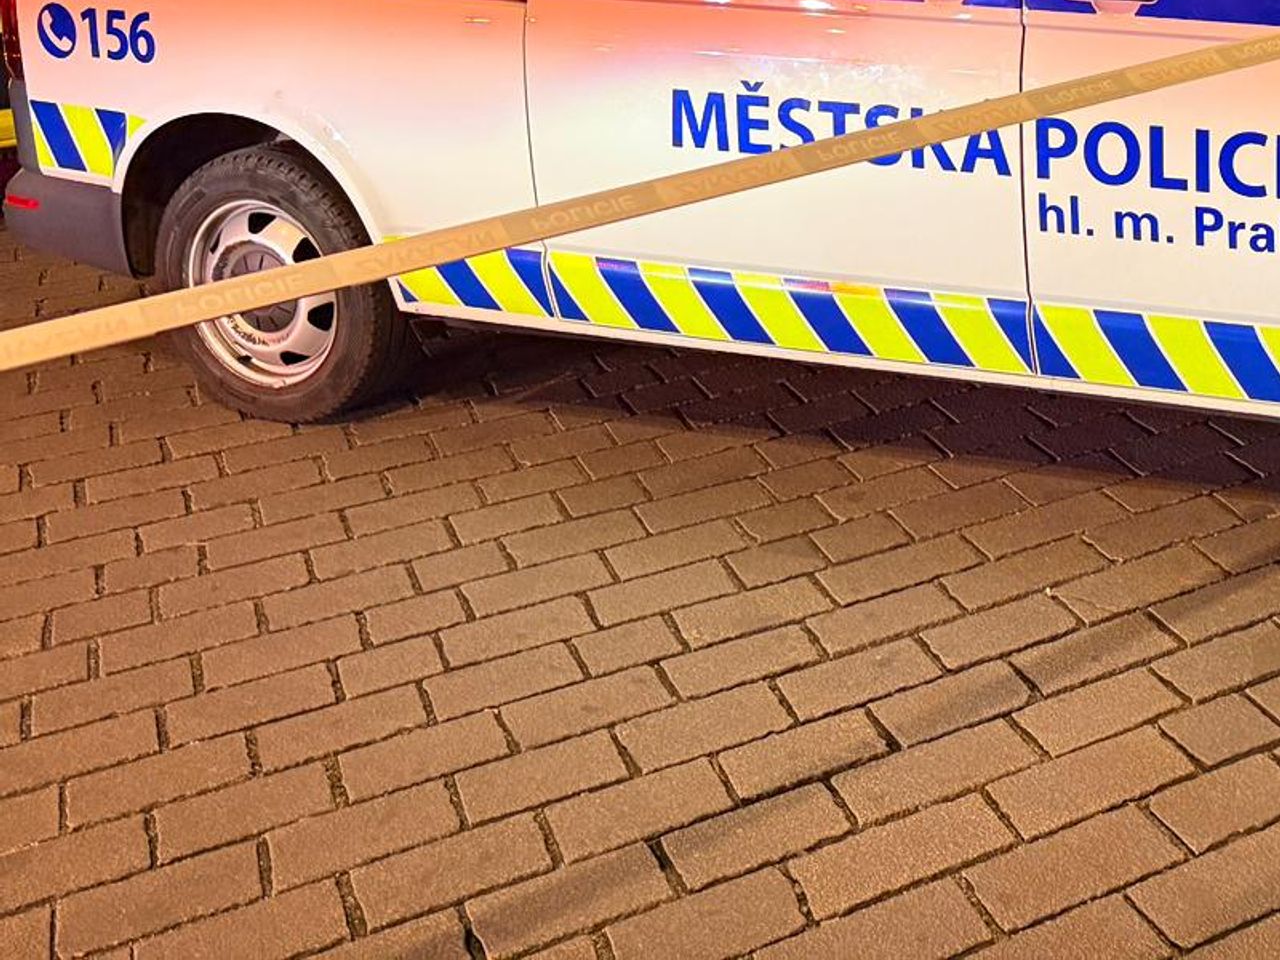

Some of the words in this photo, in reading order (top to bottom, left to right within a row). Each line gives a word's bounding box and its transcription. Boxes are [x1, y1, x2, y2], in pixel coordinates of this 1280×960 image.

[80, 7, 156, 63] 156
[1038, 192, 1094, 236] hl.
[1115, 210, 1174, 243] m.
